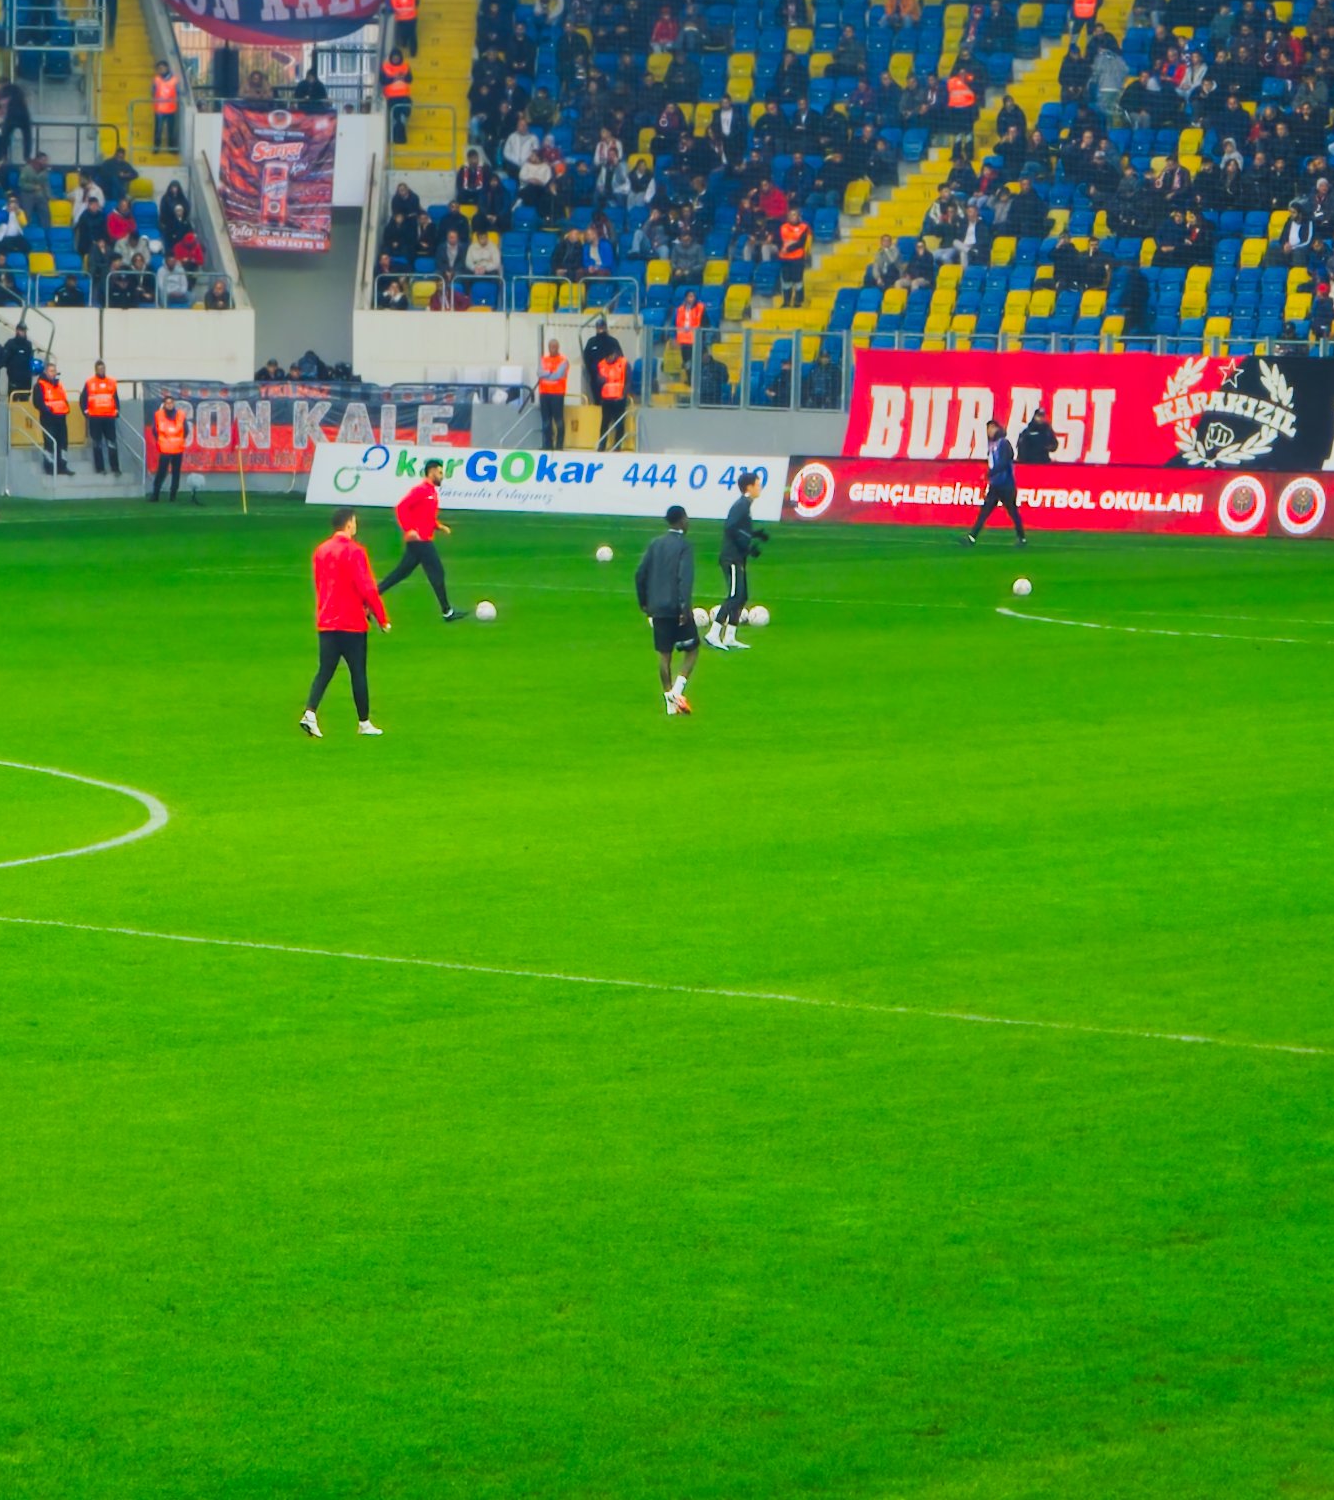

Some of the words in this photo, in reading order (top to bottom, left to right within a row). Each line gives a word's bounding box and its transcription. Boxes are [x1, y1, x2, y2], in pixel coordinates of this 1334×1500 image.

[293, 400, 455, 447] KALE
[1153, 391, 1297, 438] KARAKIZIL
[622, 463, 677, 488] 444
[689, 464, 708, 490] 0
[1016, 488, 1096, 510] FUTBOL
[1098, 491, 1203, 514] OKULLARI
